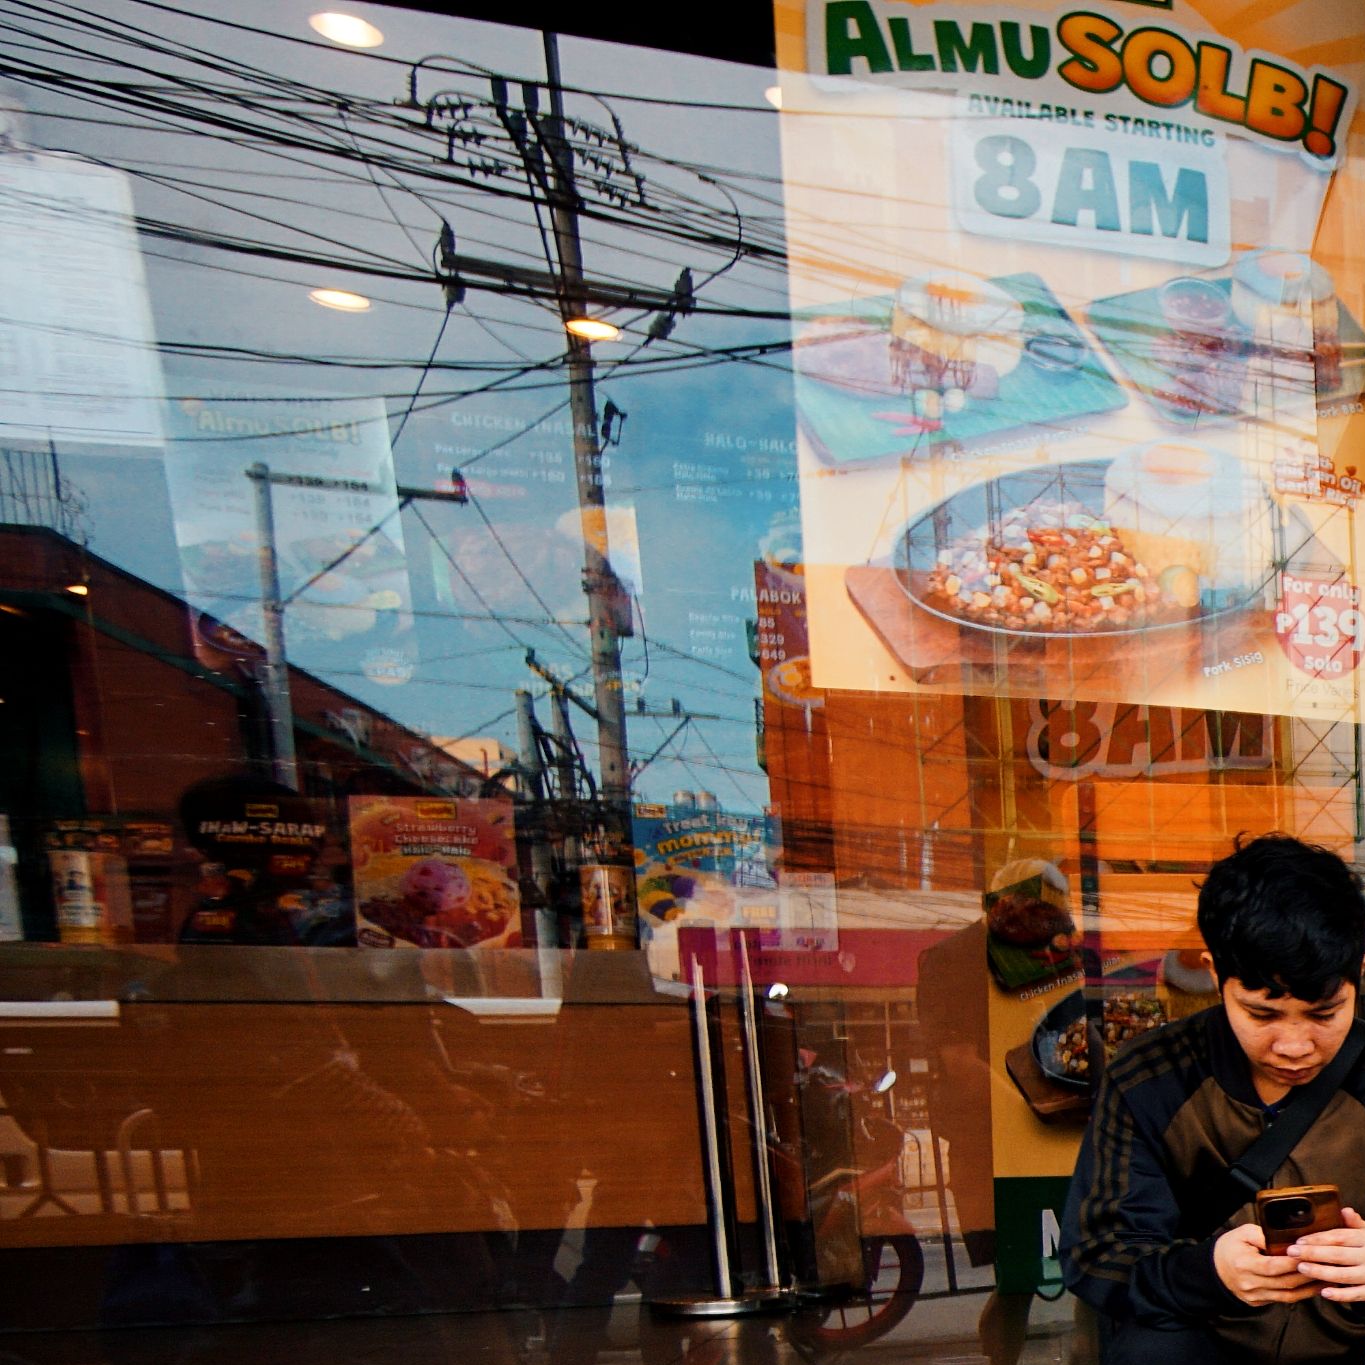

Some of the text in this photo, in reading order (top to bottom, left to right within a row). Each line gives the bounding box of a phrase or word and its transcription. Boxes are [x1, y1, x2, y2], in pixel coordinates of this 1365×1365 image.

[968, 93, 1216, 148] AVAILABLE STARTING
[973, 134, 1209, 245] 8AM
[451, 411, 526, 430] CHICKEN
[730, 585, 802, 604] PALABOK
[1282, 576, 1361, 605] For only
[1203, 650, 1265, 678] Pork Sisig
[394, 822, 478, 837] Strawberry
